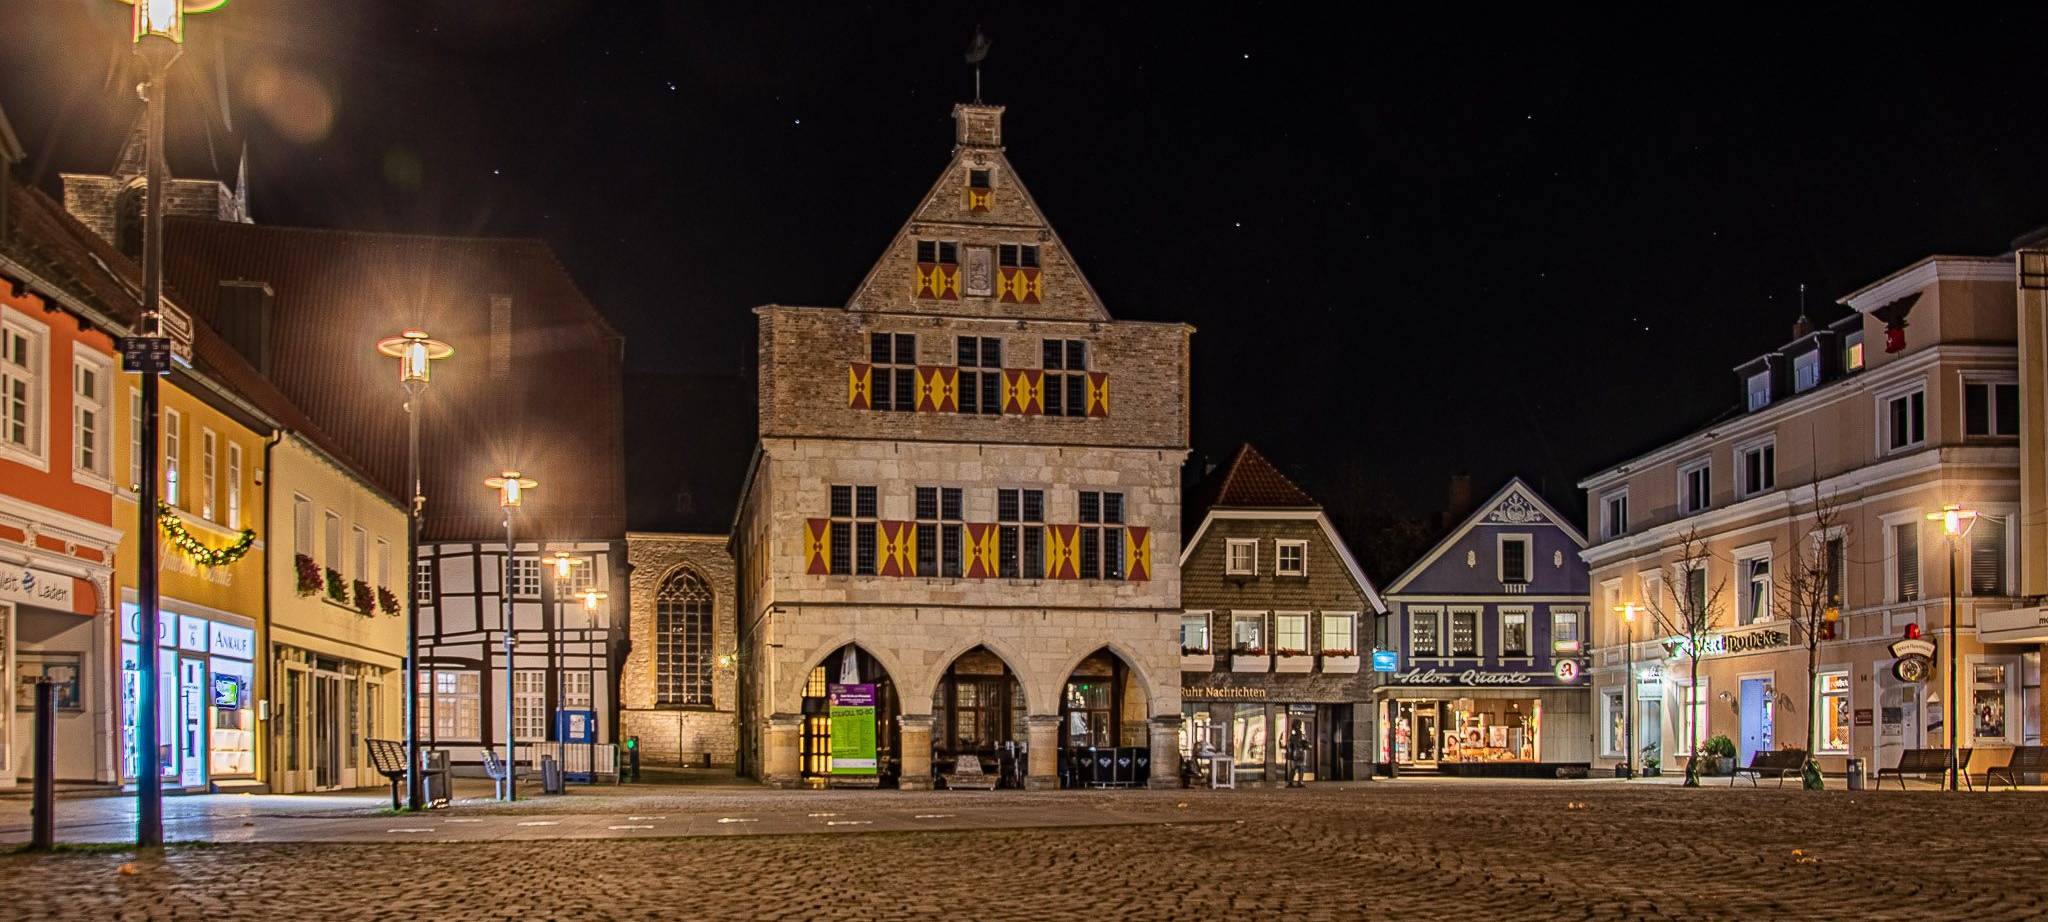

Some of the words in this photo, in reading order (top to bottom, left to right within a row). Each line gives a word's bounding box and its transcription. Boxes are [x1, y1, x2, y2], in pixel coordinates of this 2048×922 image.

[38, 577, 67, 601] Laden
[1394, 667, 1451, 685] Salon
[1205, 686, 1266, 698] Nachrichten
